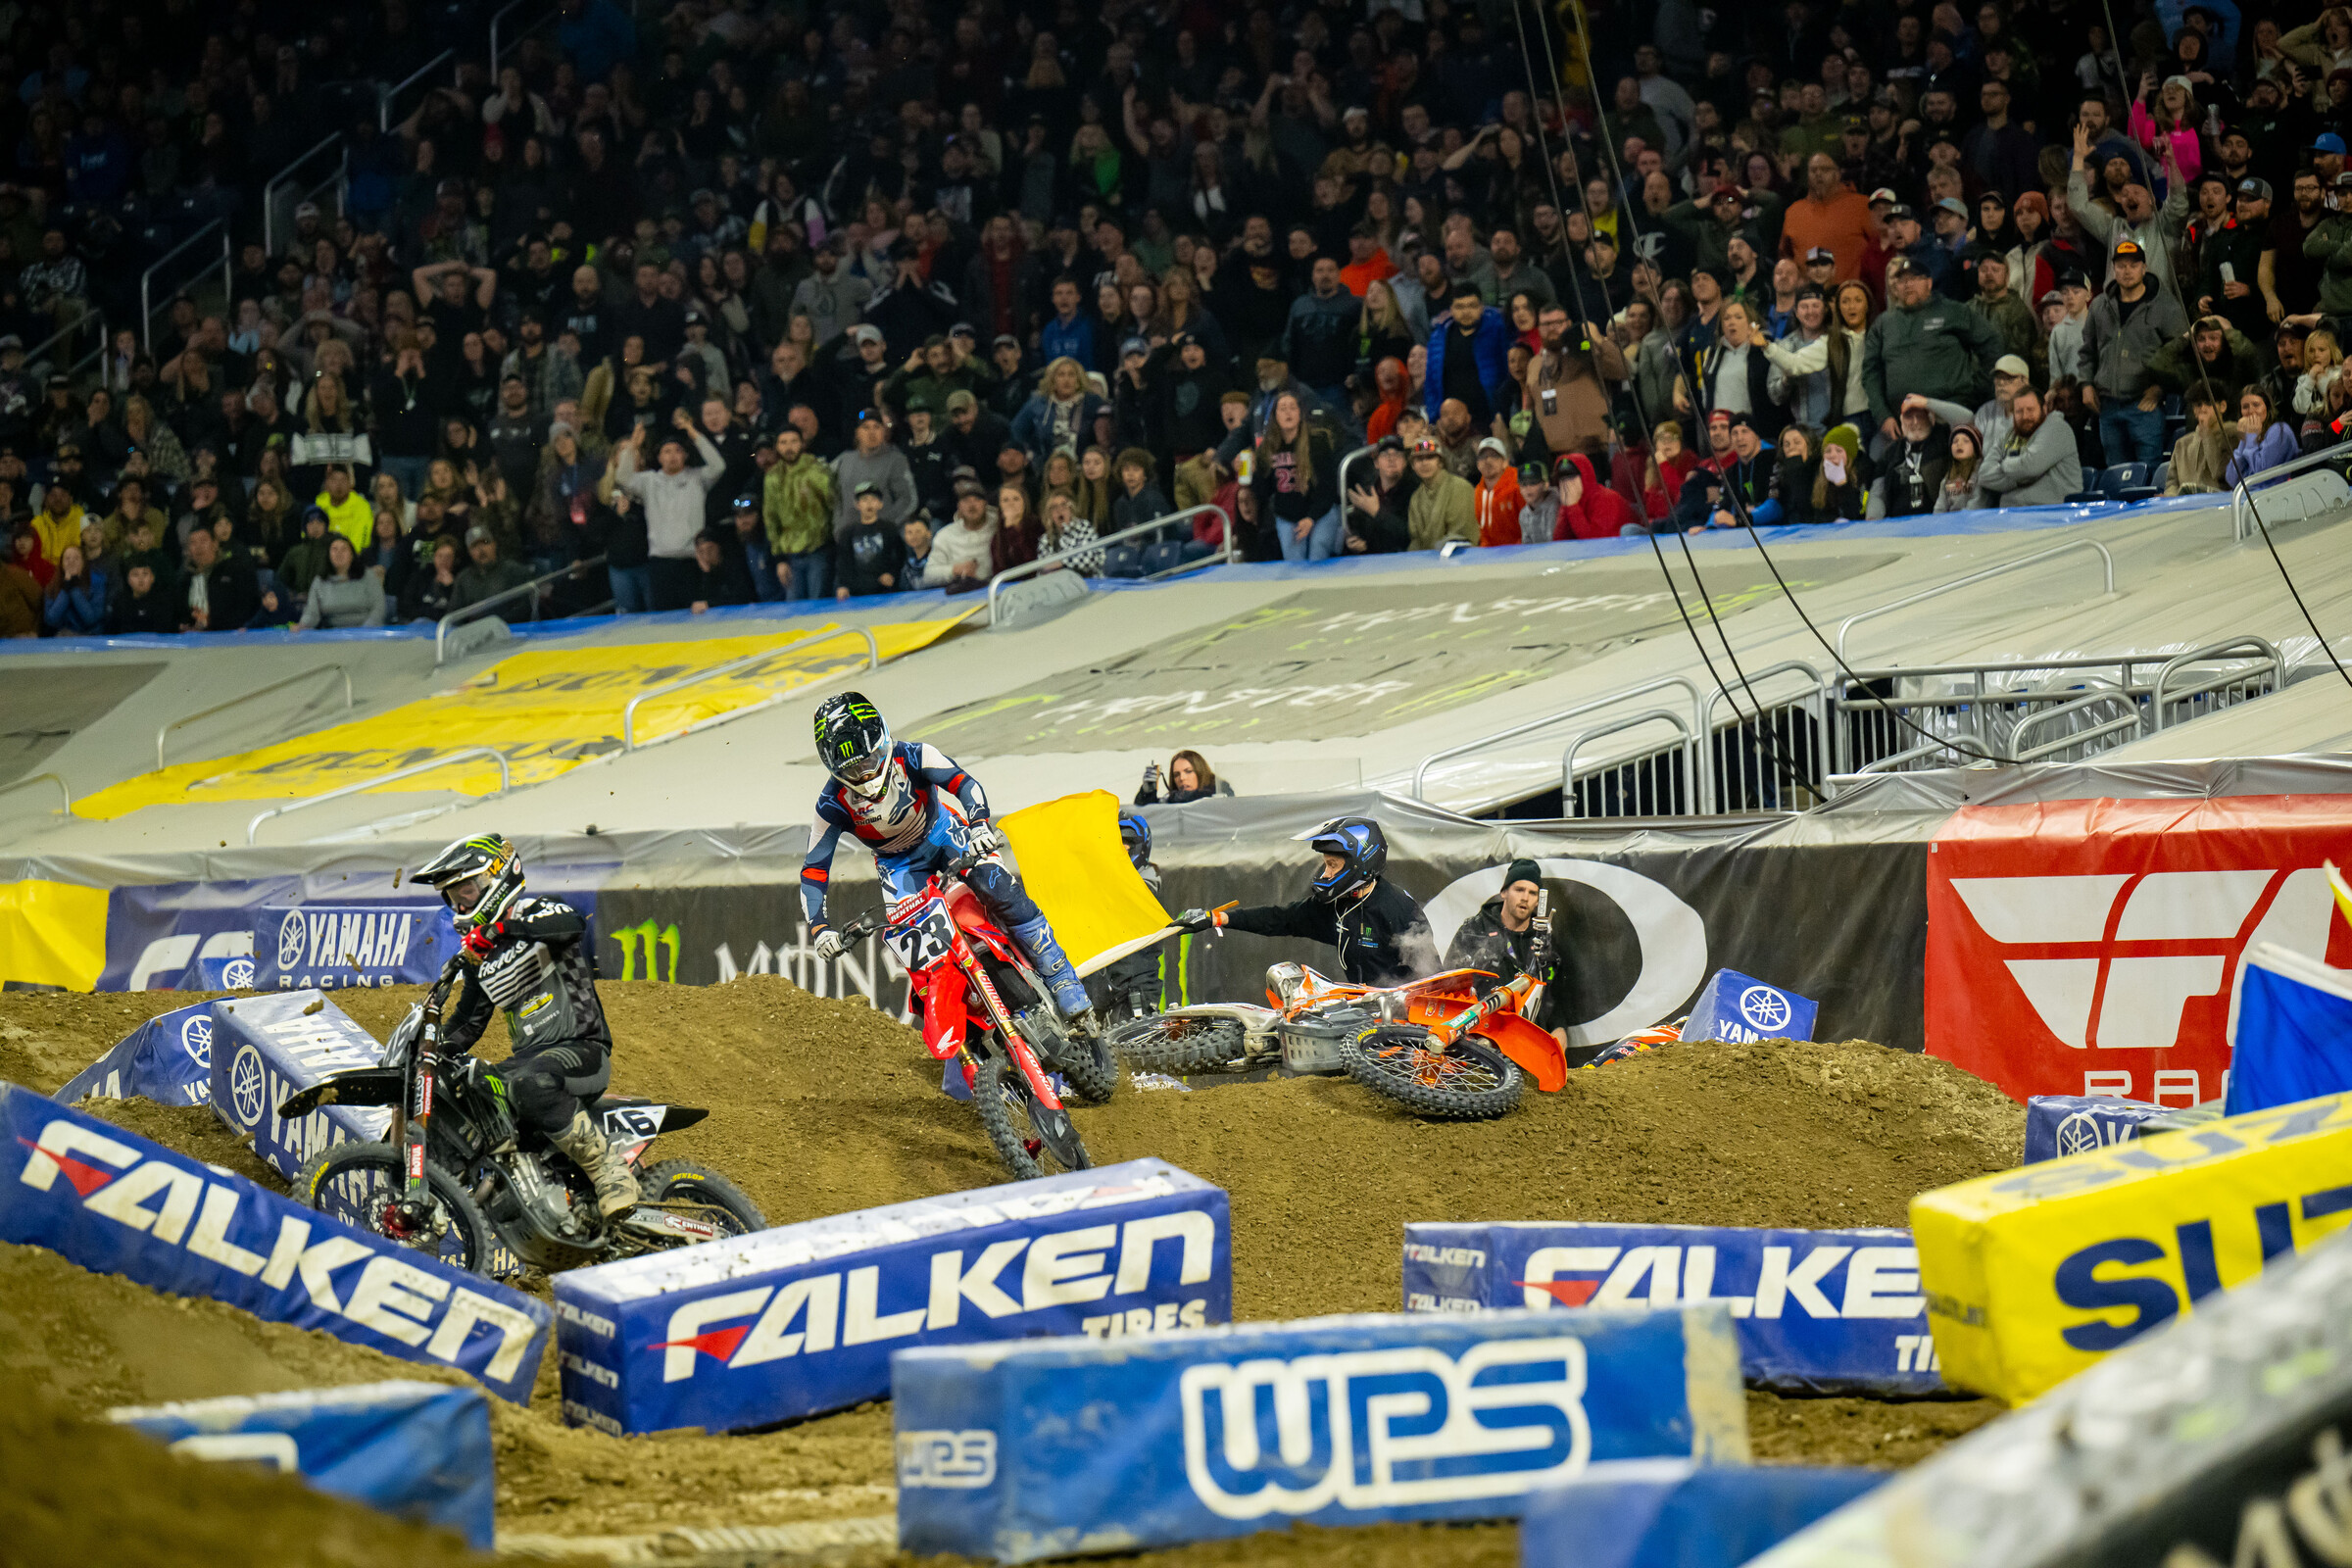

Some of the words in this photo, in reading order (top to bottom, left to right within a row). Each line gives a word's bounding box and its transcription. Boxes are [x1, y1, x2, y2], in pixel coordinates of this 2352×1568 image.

[855, 814, 882, 826] SHOWA
[890, 898, 926, 923] RENTHAL
[309, 912, 413, 968] YAMAHA
[900, 913, 953, 972] 23
[278, 974, 395, 989] RACING
[980, 974, 1010, 1018] SHOWA
[1719, 1019, 1764, 1045] YAM
[1025, 1051, 1058, 1101] DUNLOP
[412, 1146, 422, 1176] MOTUL
[670, 1172, 705, 1183] DUNLOP
[18, 1119, 537, 1384] FALKEN
[1408, 1244, 1486, 1268] FALKEN
[662, 1211, 1215, 1384] FALKEN
[1522, 1246, 1927, 1319] FALKE
[556, 1300, 616, 1340] FALKEN
[1082, 1298, 1206, 1341] TIRES
[1407, 1294, 1482, 1315] FALKEN
[559, 1349, 619, 1391] FALKEN
[1180, 1336, 1591, 1520] WPS
